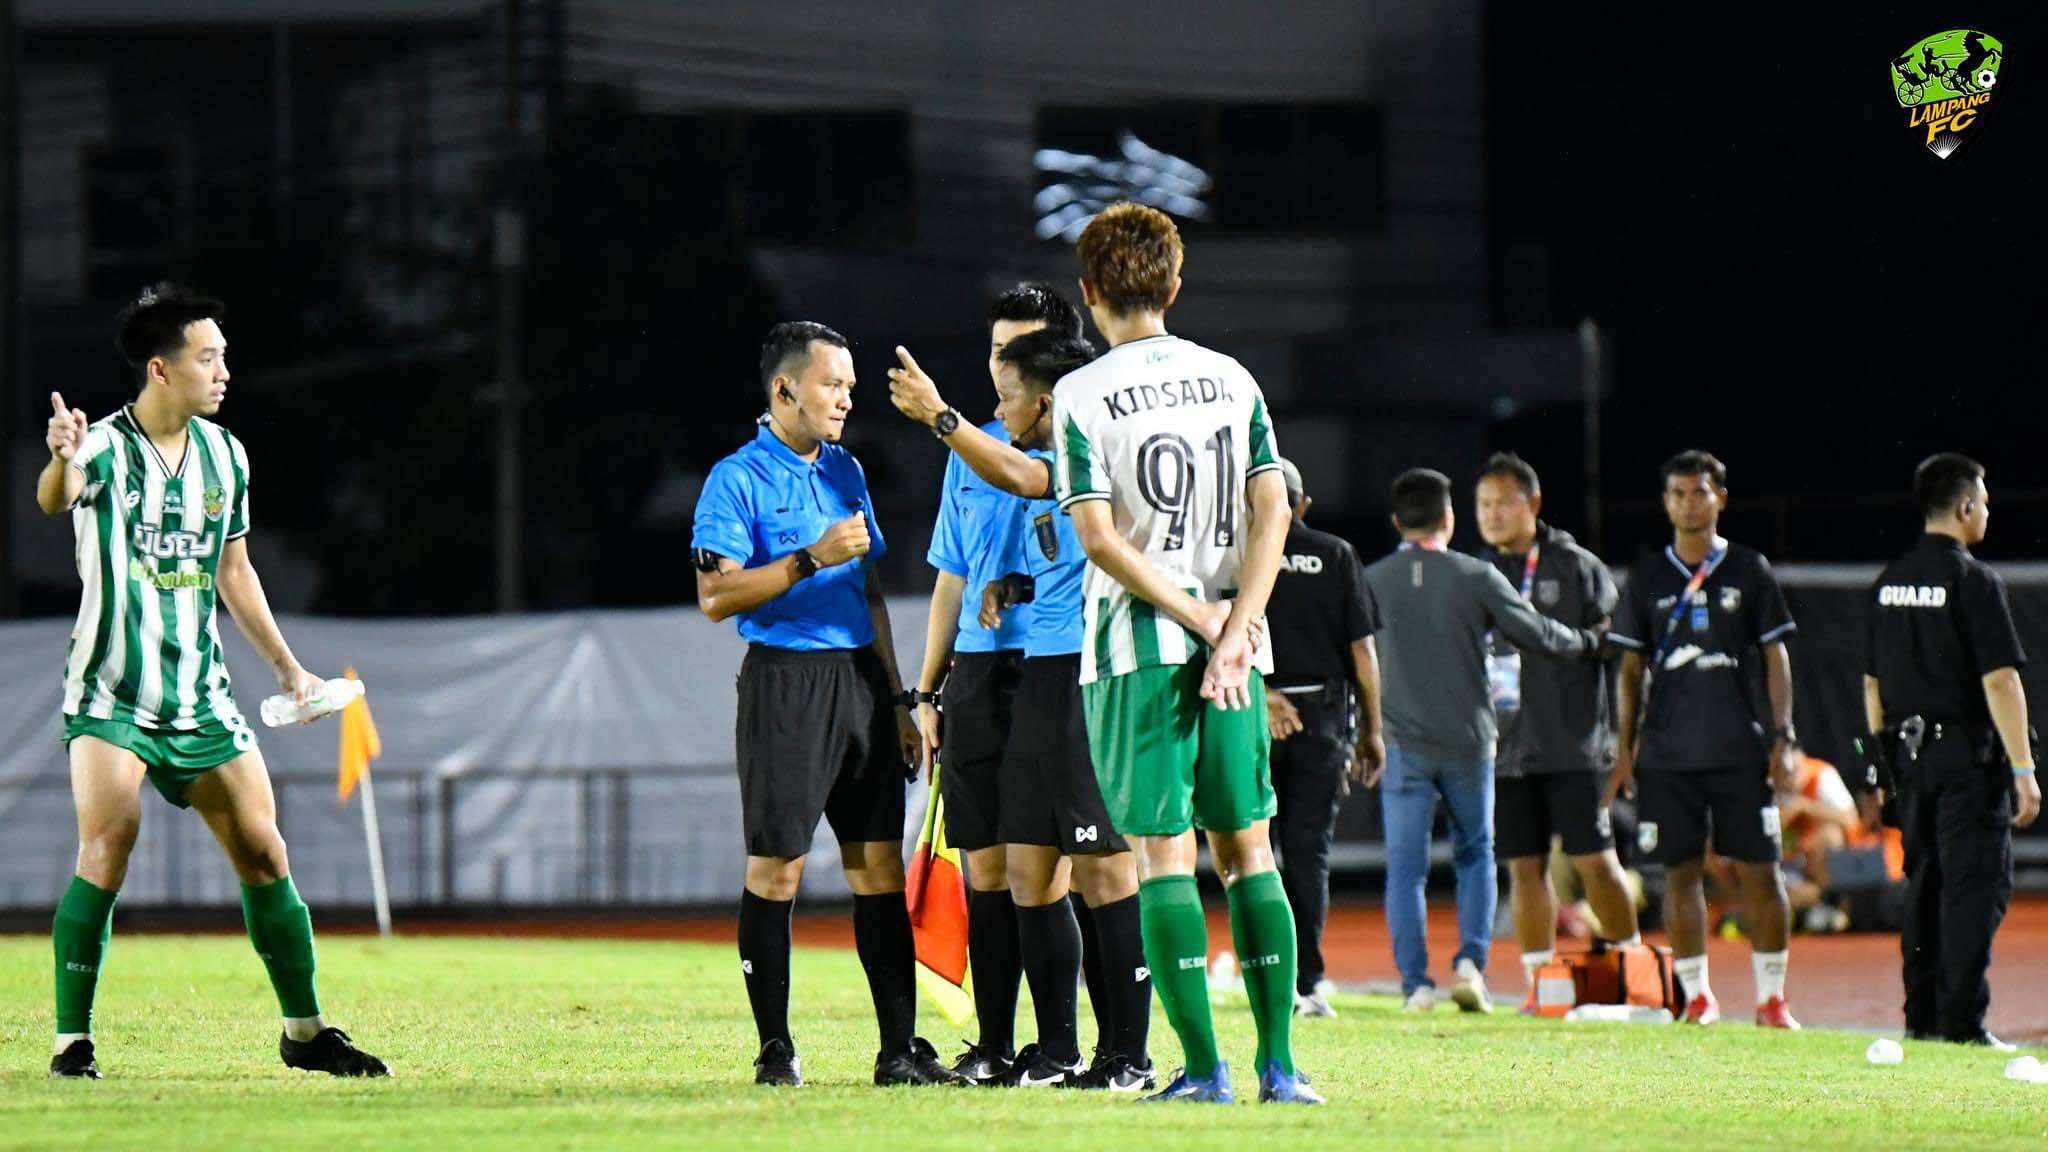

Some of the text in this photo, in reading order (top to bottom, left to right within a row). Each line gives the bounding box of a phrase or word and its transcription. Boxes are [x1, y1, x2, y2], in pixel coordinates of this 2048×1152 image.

[1136, 425, 1234, 551] 91
[1280, 554, 1323, 574] ARD
[1879, 585, 1947, 607] GUARD
